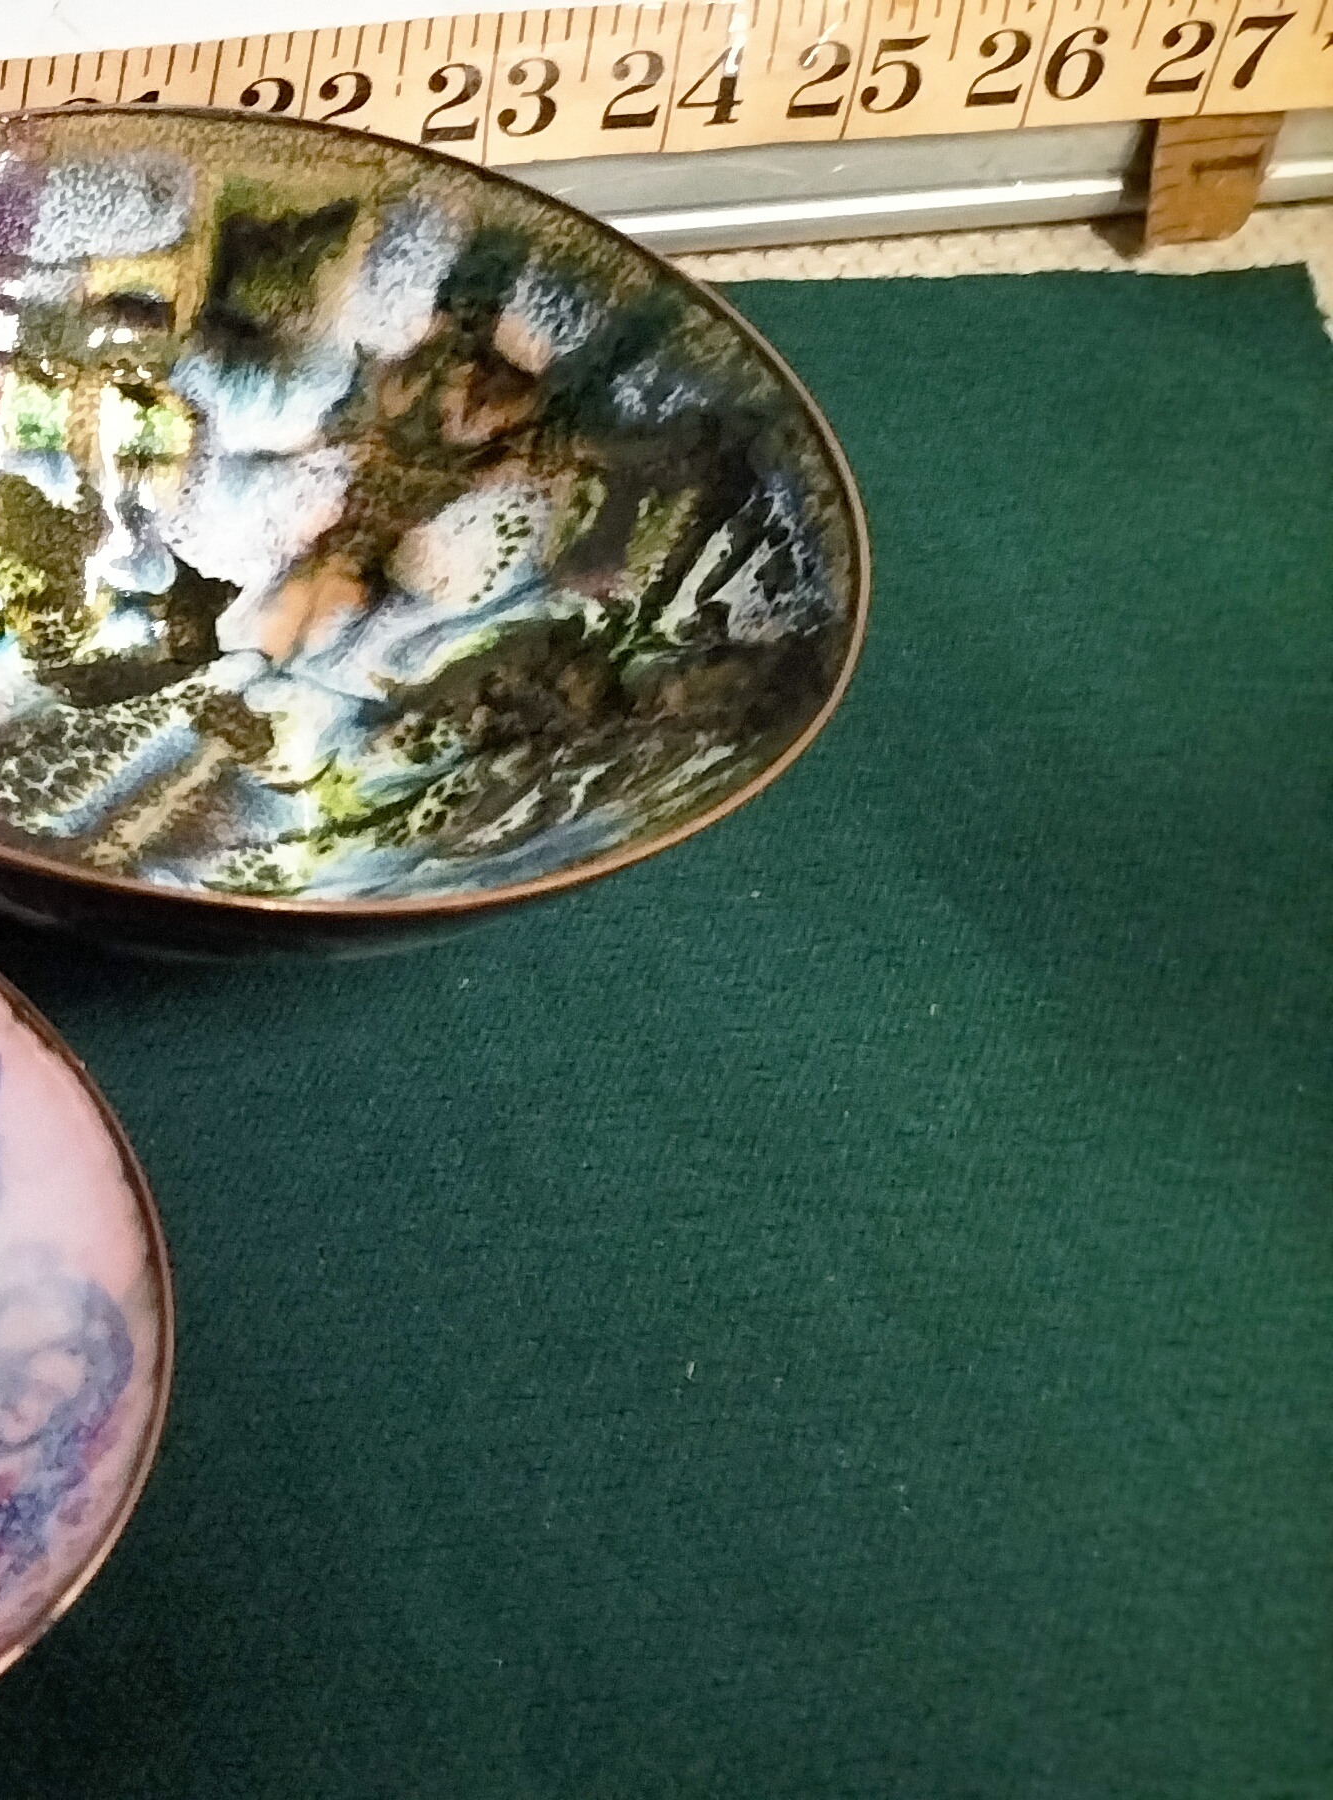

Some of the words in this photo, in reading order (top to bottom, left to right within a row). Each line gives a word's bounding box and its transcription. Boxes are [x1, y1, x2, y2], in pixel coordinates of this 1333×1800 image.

[420, 56, 560, 144] 23
[600, 43, 743, 130] 24
[787, 33, 930, 119] 25
[966, 26, 1109, 107] 26
[1145, 12, 1298, 95] 27
